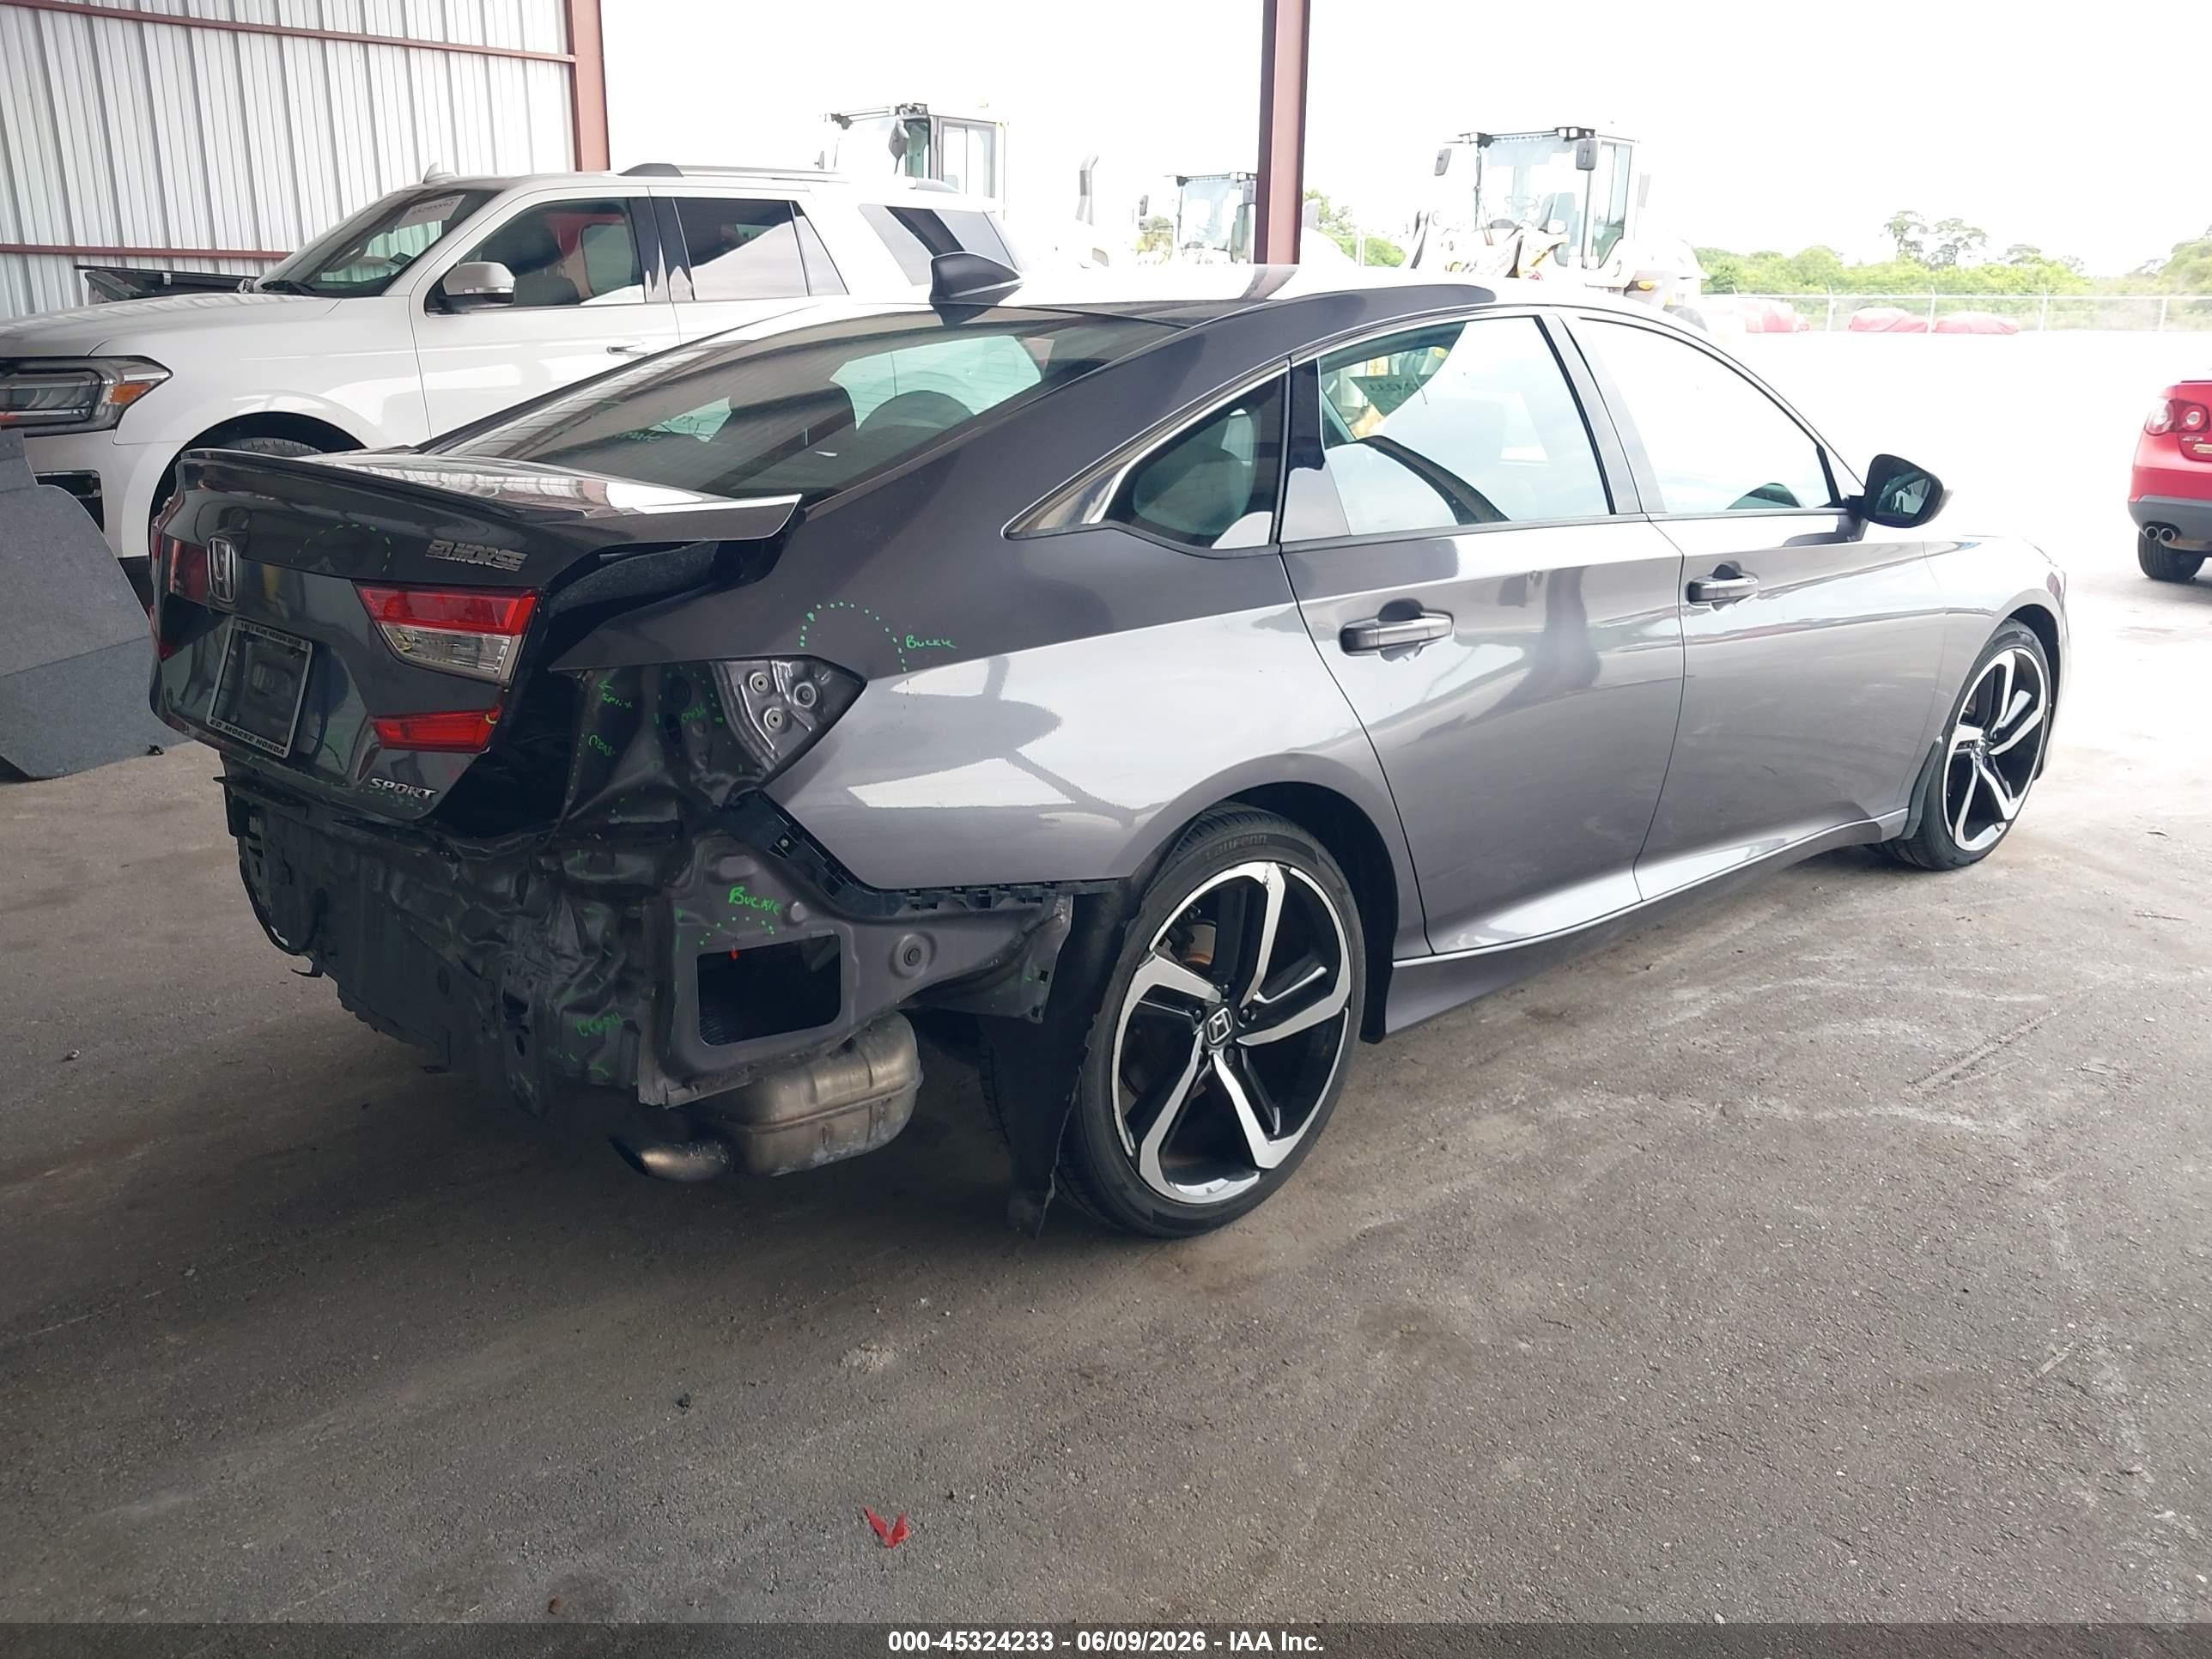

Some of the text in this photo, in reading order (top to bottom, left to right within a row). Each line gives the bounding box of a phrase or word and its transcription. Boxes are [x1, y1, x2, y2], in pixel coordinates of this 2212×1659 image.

[450, 542, 528, 571] MORSE
[210, 719, 285, 756] ED MORSE HONDA
[368, 777, 437, 799] SPORT
